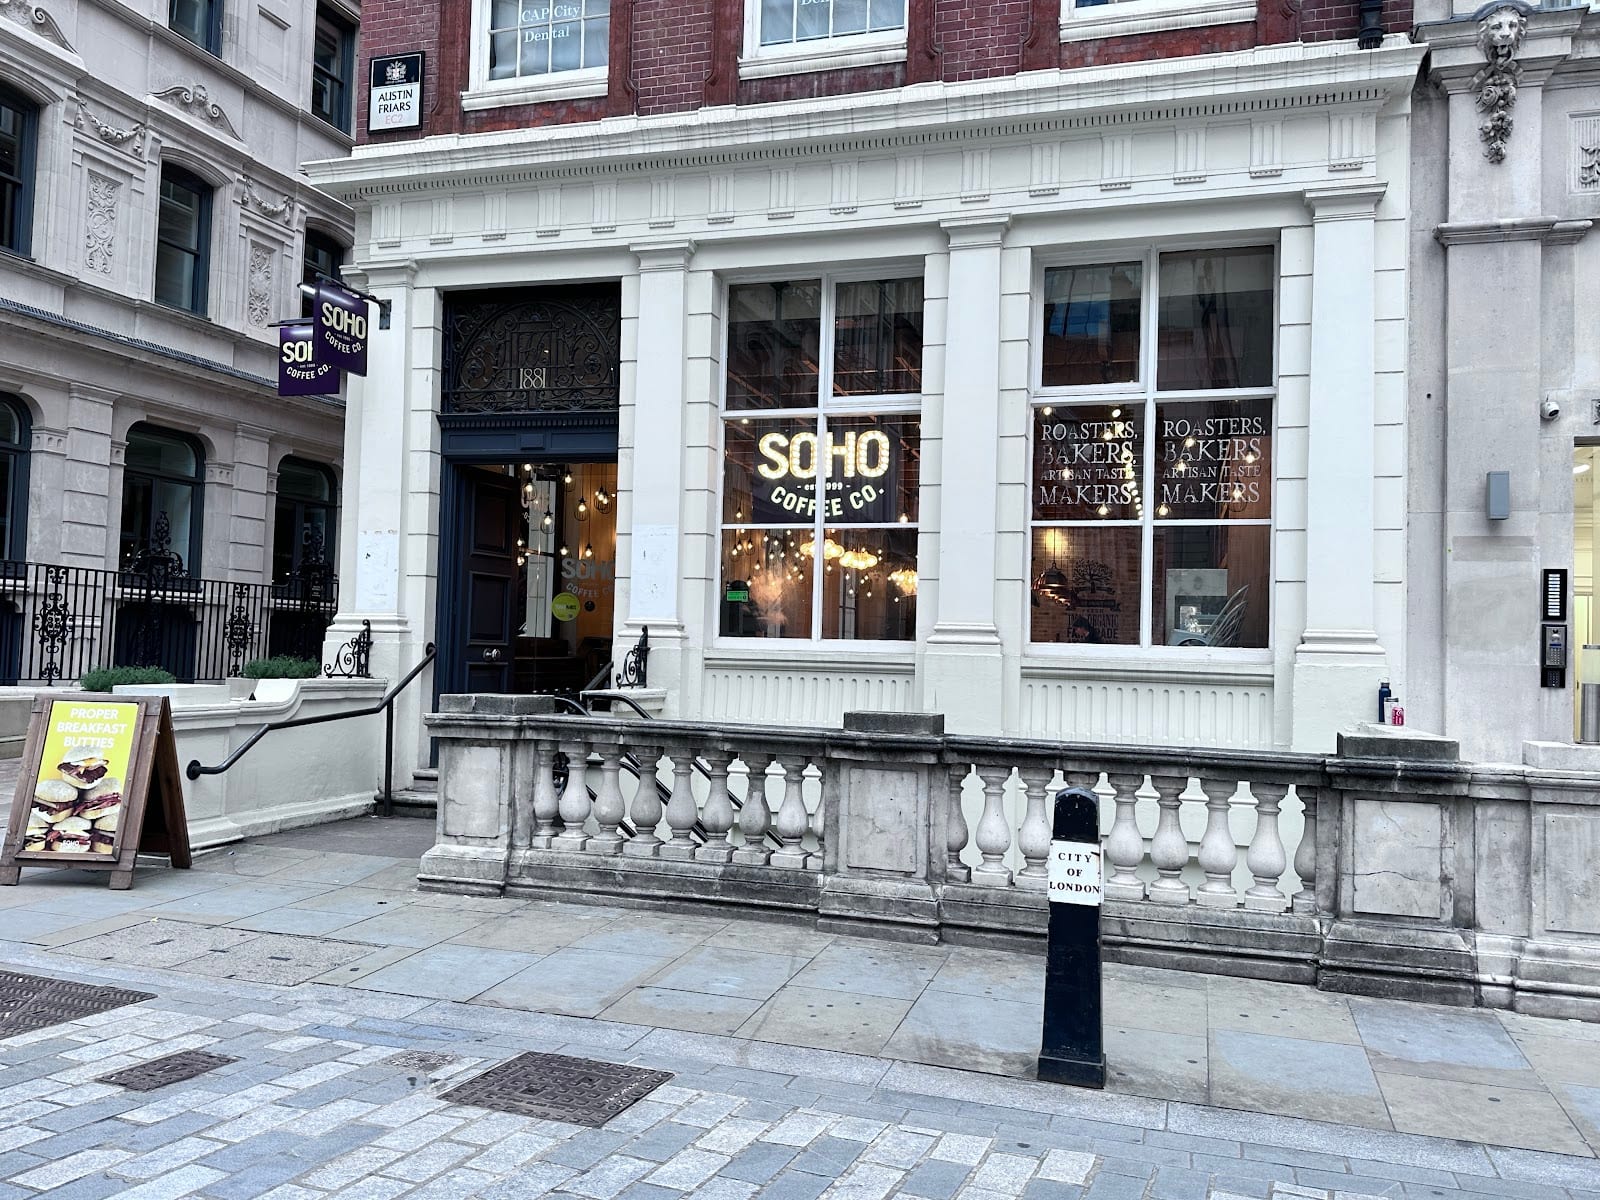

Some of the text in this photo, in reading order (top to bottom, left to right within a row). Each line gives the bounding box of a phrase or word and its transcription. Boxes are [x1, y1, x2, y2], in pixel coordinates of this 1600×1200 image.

[522, 5, 580, 22] CAP City
[524, 26, 570, 43] Dental
[378, 89, 413, 102] AUSTIN
[378, 101, 411, 114] FRIARS
[385, 113, 403, 125] EC2
[321, 302, 367, 340] SOHO
[325, 331, 351, 354] COFFEE
[351, 342, 364, 353] CO.
[286, 363, 332, 380] COFFEE CO.
[519, 367, 546, 389] 1881
[1041, 421, 1138, 441] ROASTERS,
[1163, 417, 1266, 437] ROASTERS,
[757, 430, 890, 480] SOHO
[1224, 465, 1261, 477] TASTE
[770, 484, 885, 517] COFFEE CO.
[1039, 484, 1132, 505] MAKERS
[1162, 482, 1260, 504] MAKERS
[70, 708, 118, 720] PROPER
[57, 722, 127, 734] BREAKFAST
[64, 736, 114, 748] BUTTIES
[1058, 852, 1092, 863] CITY
[1066, 868, 1083, 877] OF
[1049, 881, 1100, 893] LONDON
